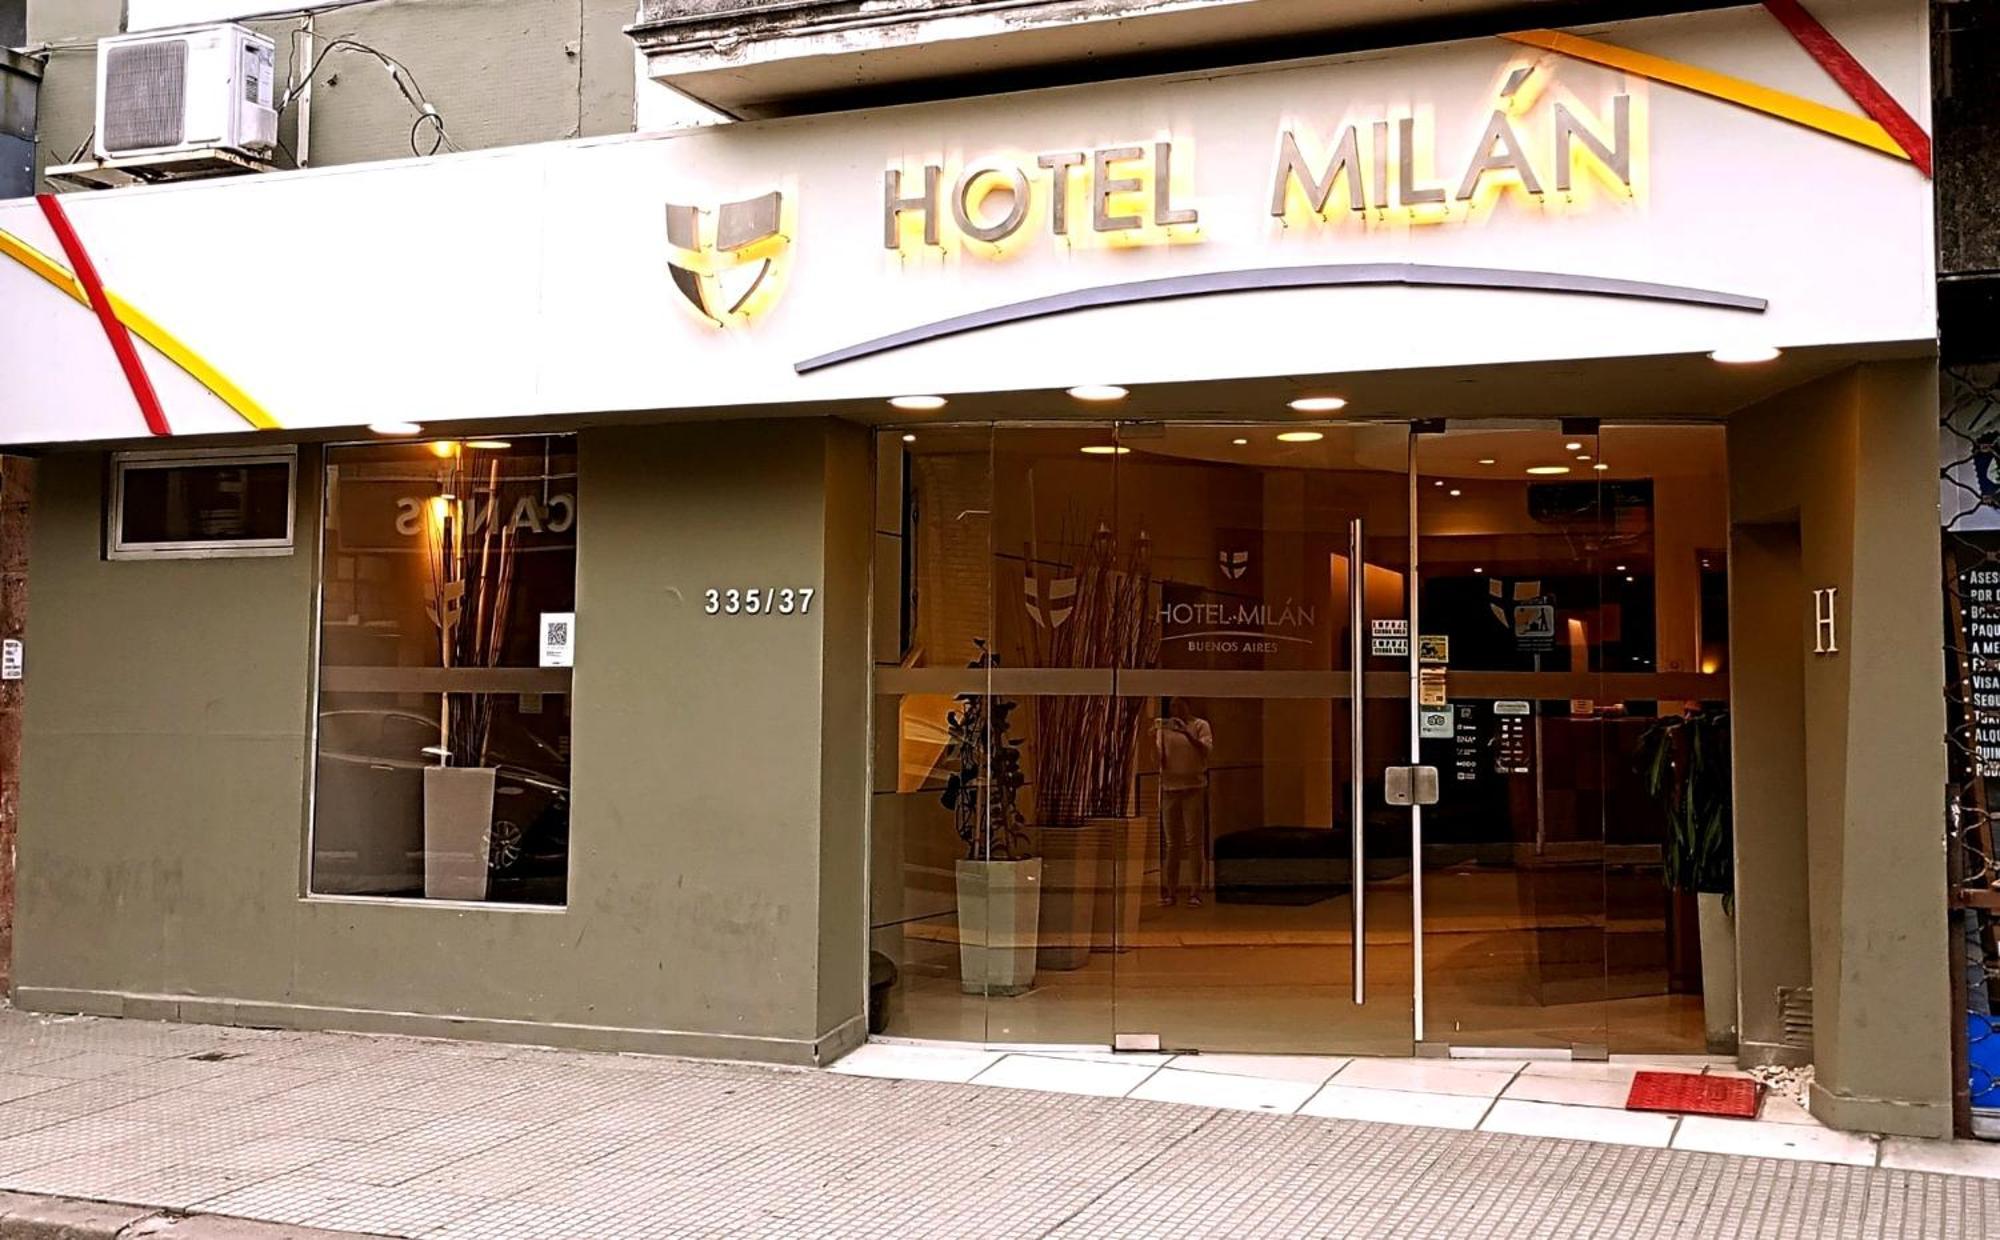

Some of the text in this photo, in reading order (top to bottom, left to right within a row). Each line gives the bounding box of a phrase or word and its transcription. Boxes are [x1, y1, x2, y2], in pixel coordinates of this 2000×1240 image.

[885, 66, 1631, 249] HOTEL MILÁN
[1970, 570, 2000, 584] ASES
[704, 588, 815, 614] 335/37
[1156, 597, 1315, 625] HOTEL MILÁN
[1813, 588, 1839, 653] H
[1188, 641, 1279, 653] BUENOS AIRES
[1972, 642, 1980, 654] A
[1972, 675, 2000, 689] VISA
